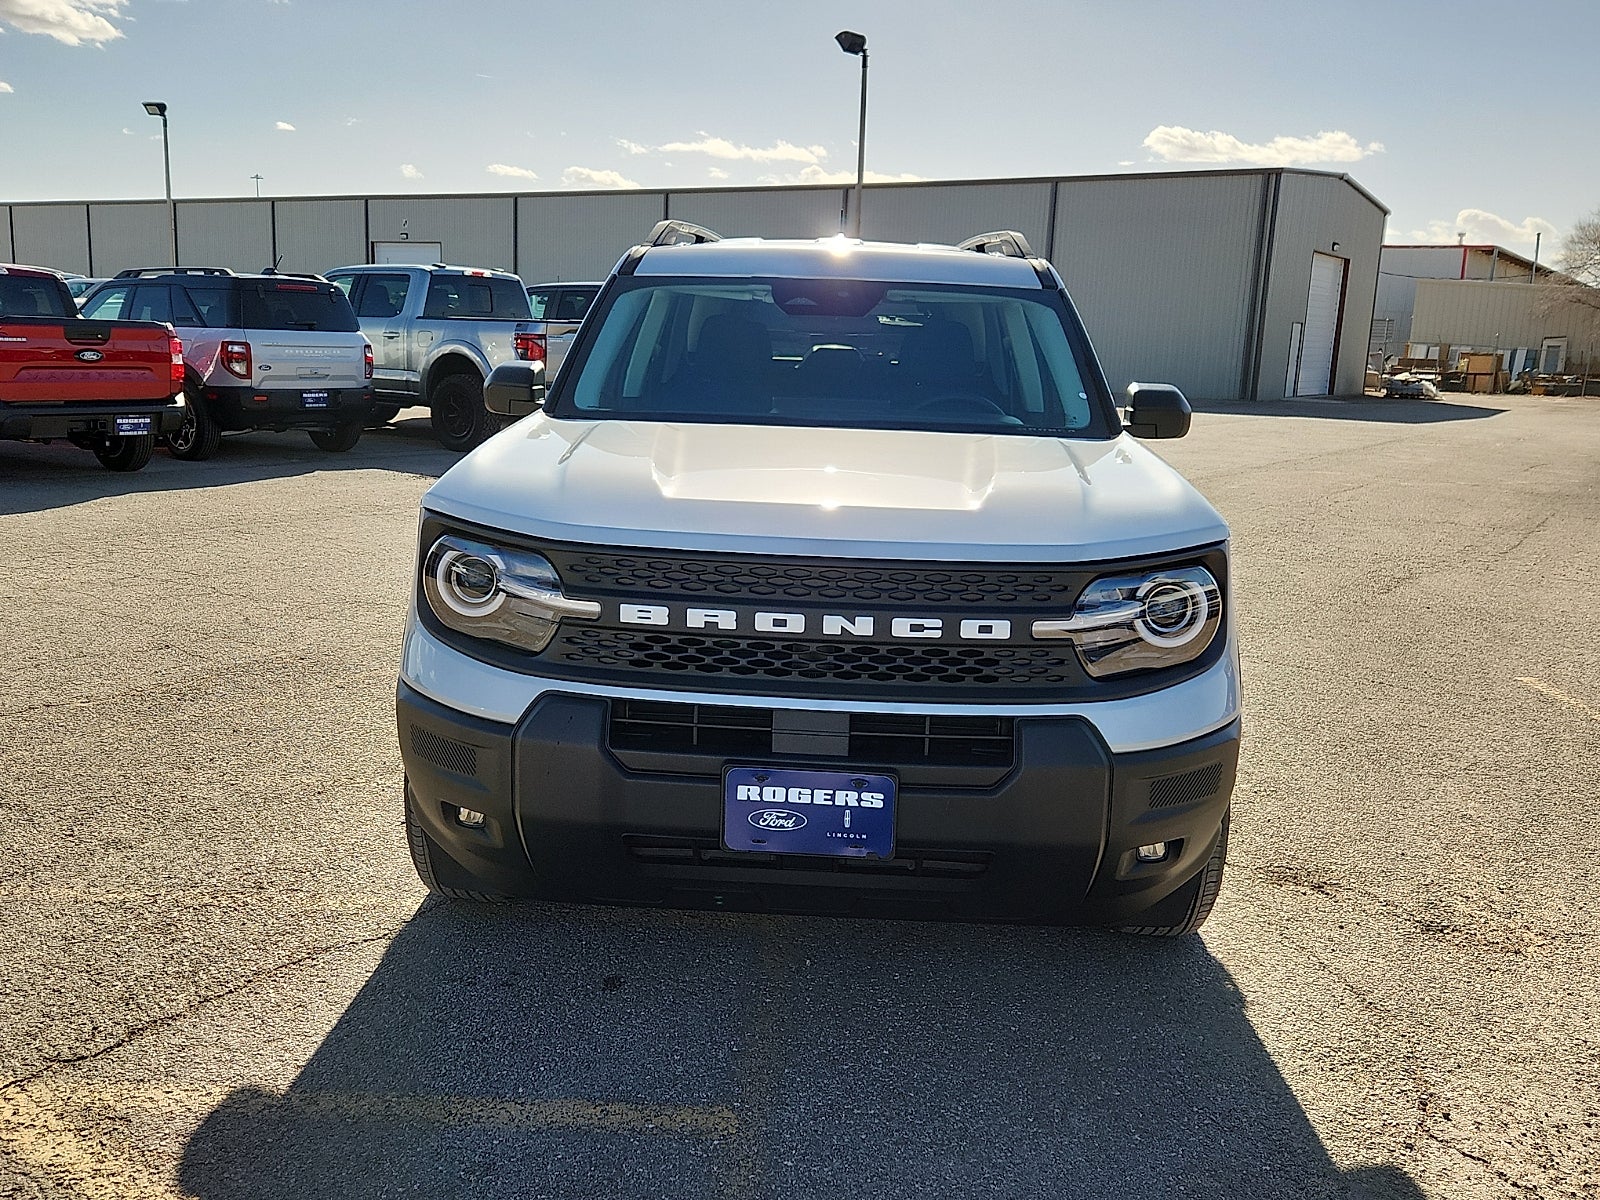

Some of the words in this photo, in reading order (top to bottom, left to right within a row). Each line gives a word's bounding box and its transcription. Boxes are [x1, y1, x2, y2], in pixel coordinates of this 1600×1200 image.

[618, 603, 1011, 640] BRONCO
[736, 784, 886, 809] ROGERS
[757, 809, 797, 829] Ford
[826, 831, 868, 840] LINCOLN
